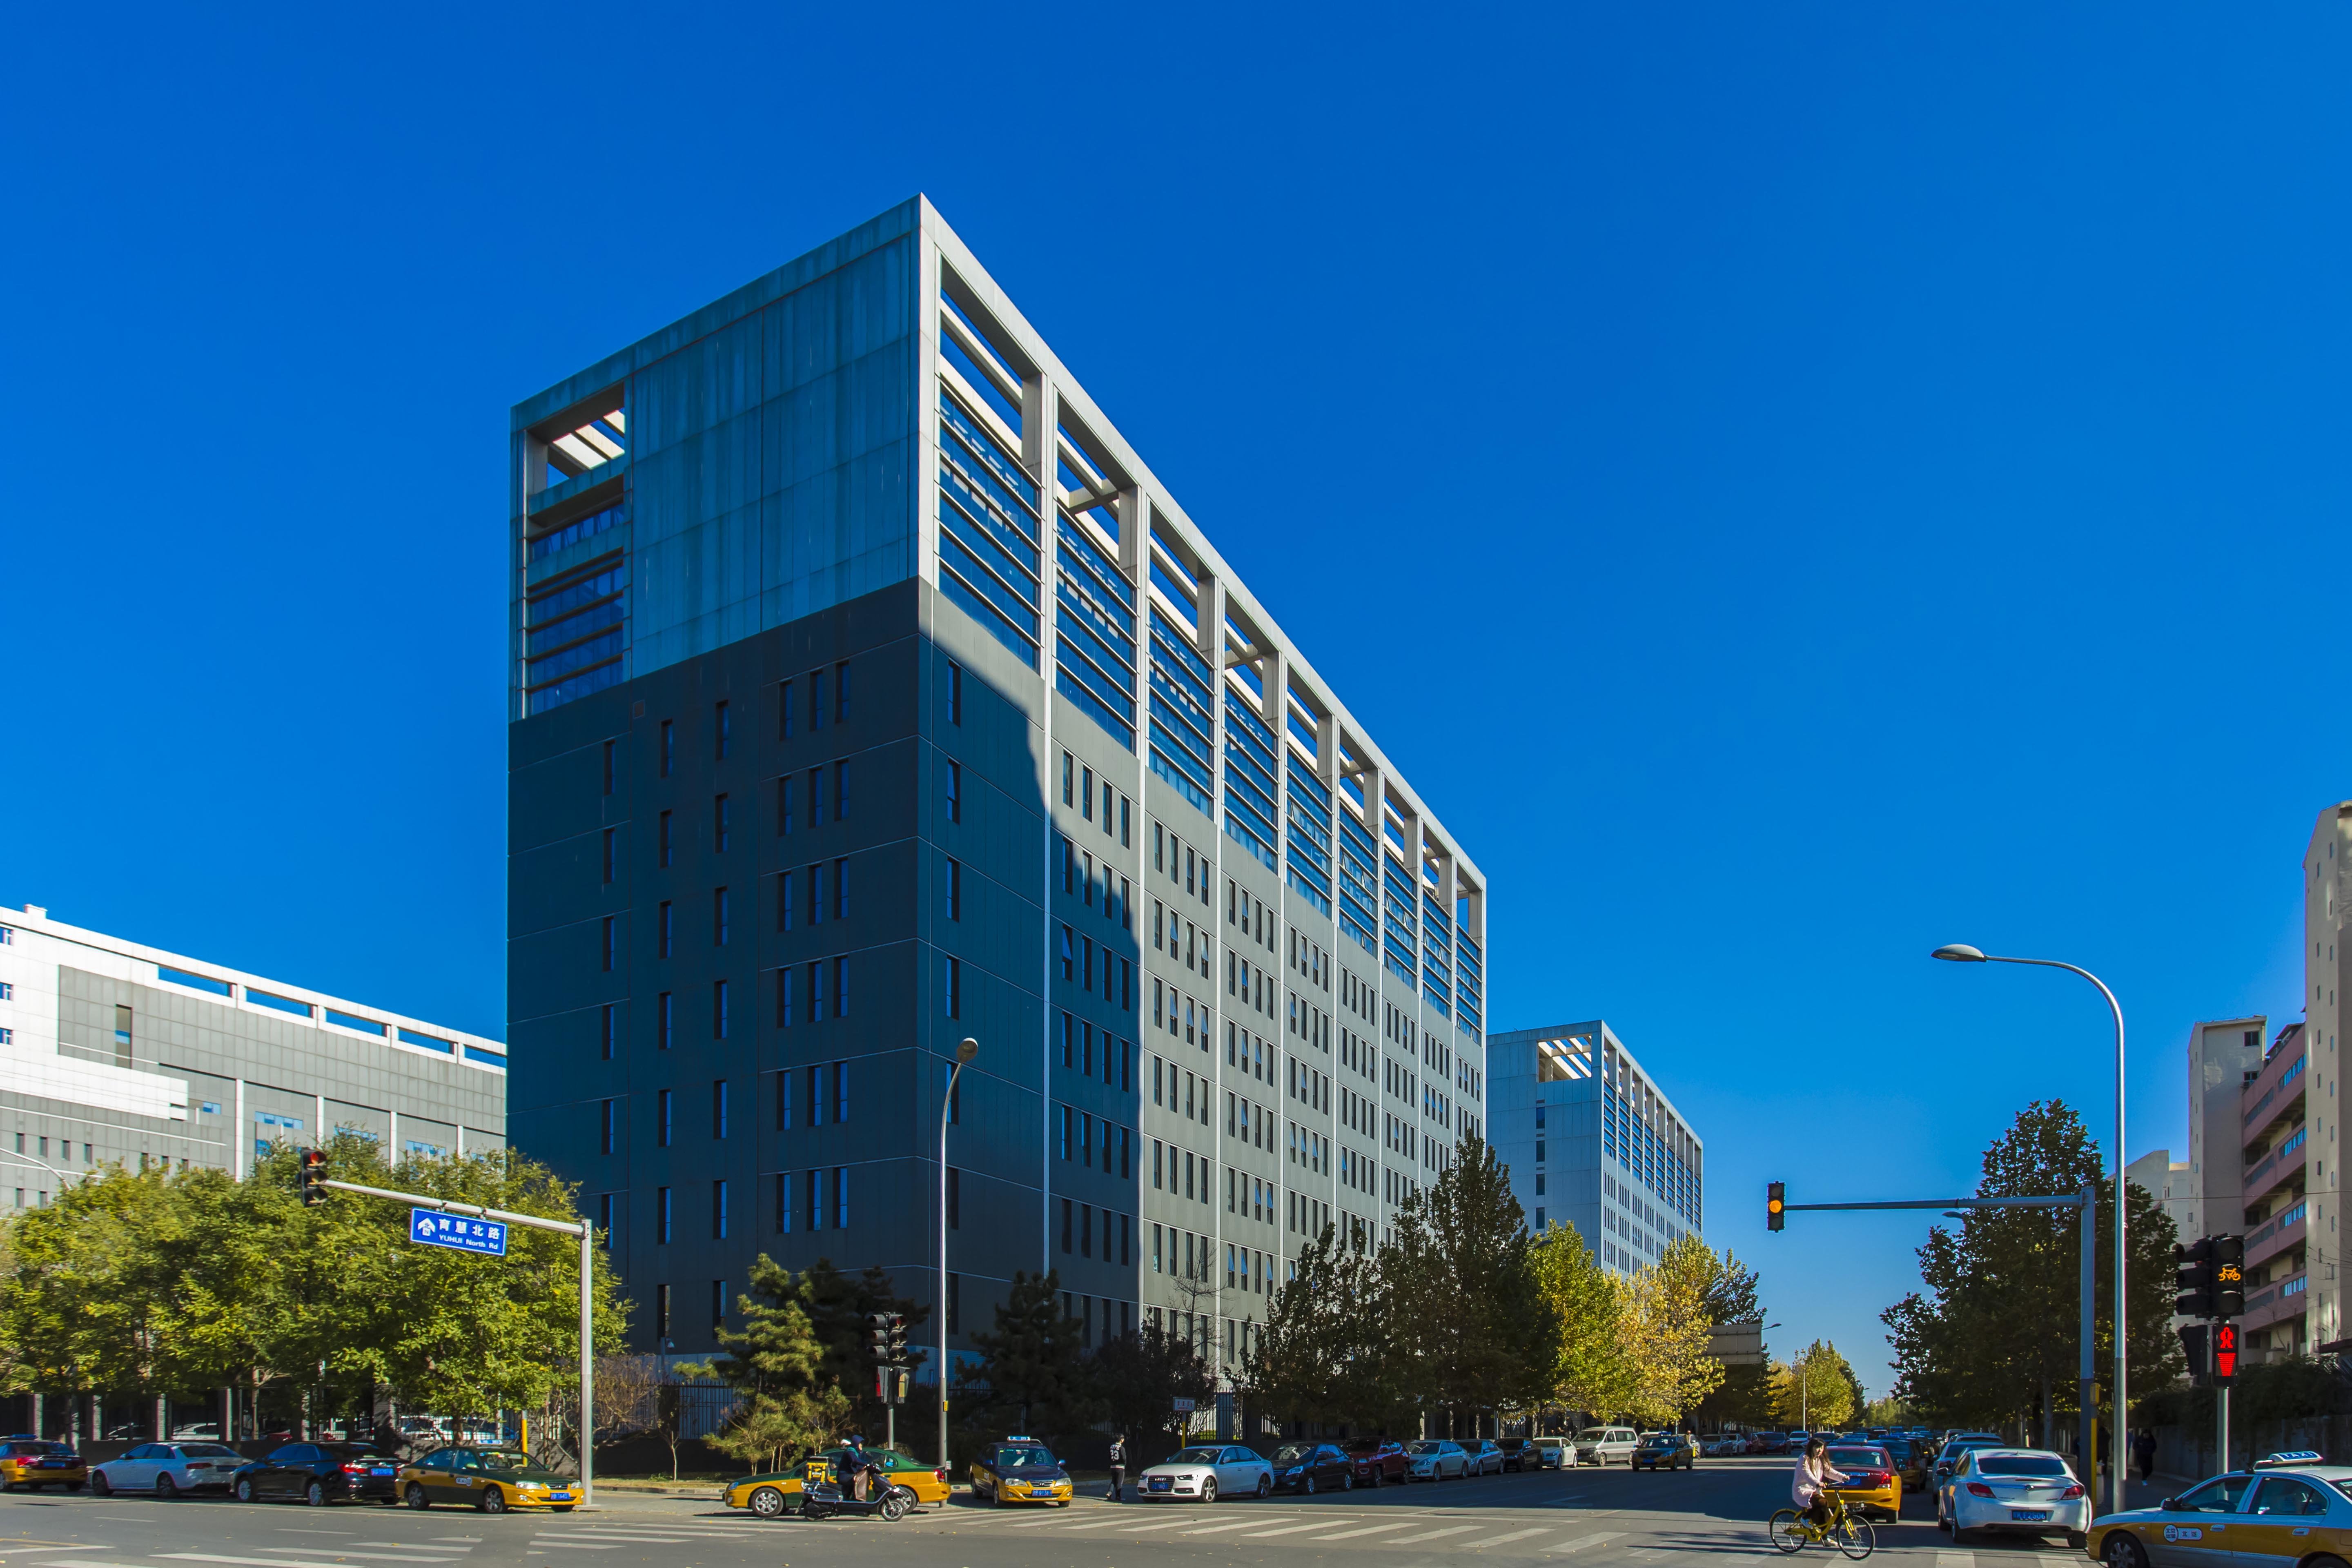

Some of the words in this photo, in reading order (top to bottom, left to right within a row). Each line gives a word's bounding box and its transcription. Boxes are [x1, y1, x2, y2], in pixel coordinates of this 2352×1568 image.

[438, 1218, 500, 1240] 育慧北路
[439, 1234, 463, 1244] YUHUI
[466, 1238, 486, 1248] North
